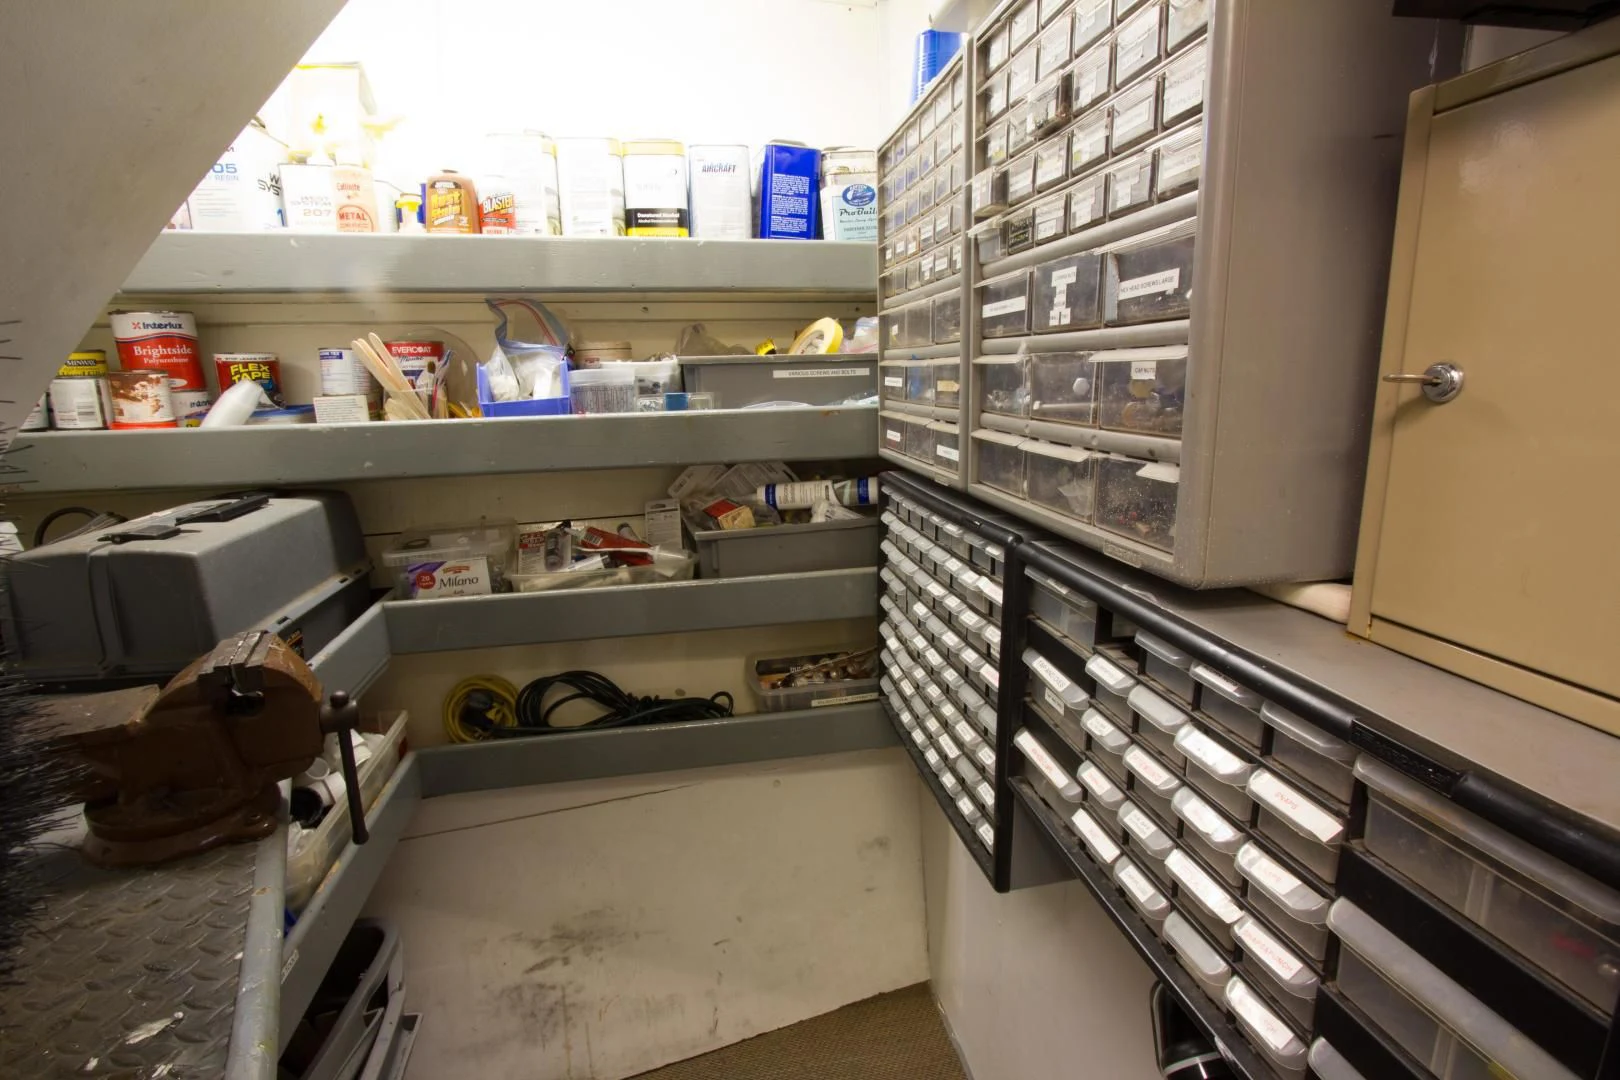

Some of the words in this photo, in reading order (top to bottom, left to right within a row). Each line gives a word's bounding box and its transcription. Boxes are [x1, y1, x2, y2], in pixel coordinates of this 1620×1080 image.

[211, 163, 237, 174] 05
[702, 163, 737, 173] AIRCRAFT
[482, 195, 513, 214] BLASTER
[338, 212, 368, 221] METAL
[143, 321, 184, 330] Interlux
[133, 344, 193, 358] Brightside
[391, 345, 432, 354] EVERCOAT
[143, 357, 189, 365] Polyurethane
[230, 362, 269, 376] FLEX
[231, 371, 271, 384] TAPE
[438, 575, 479, 590] Milano
